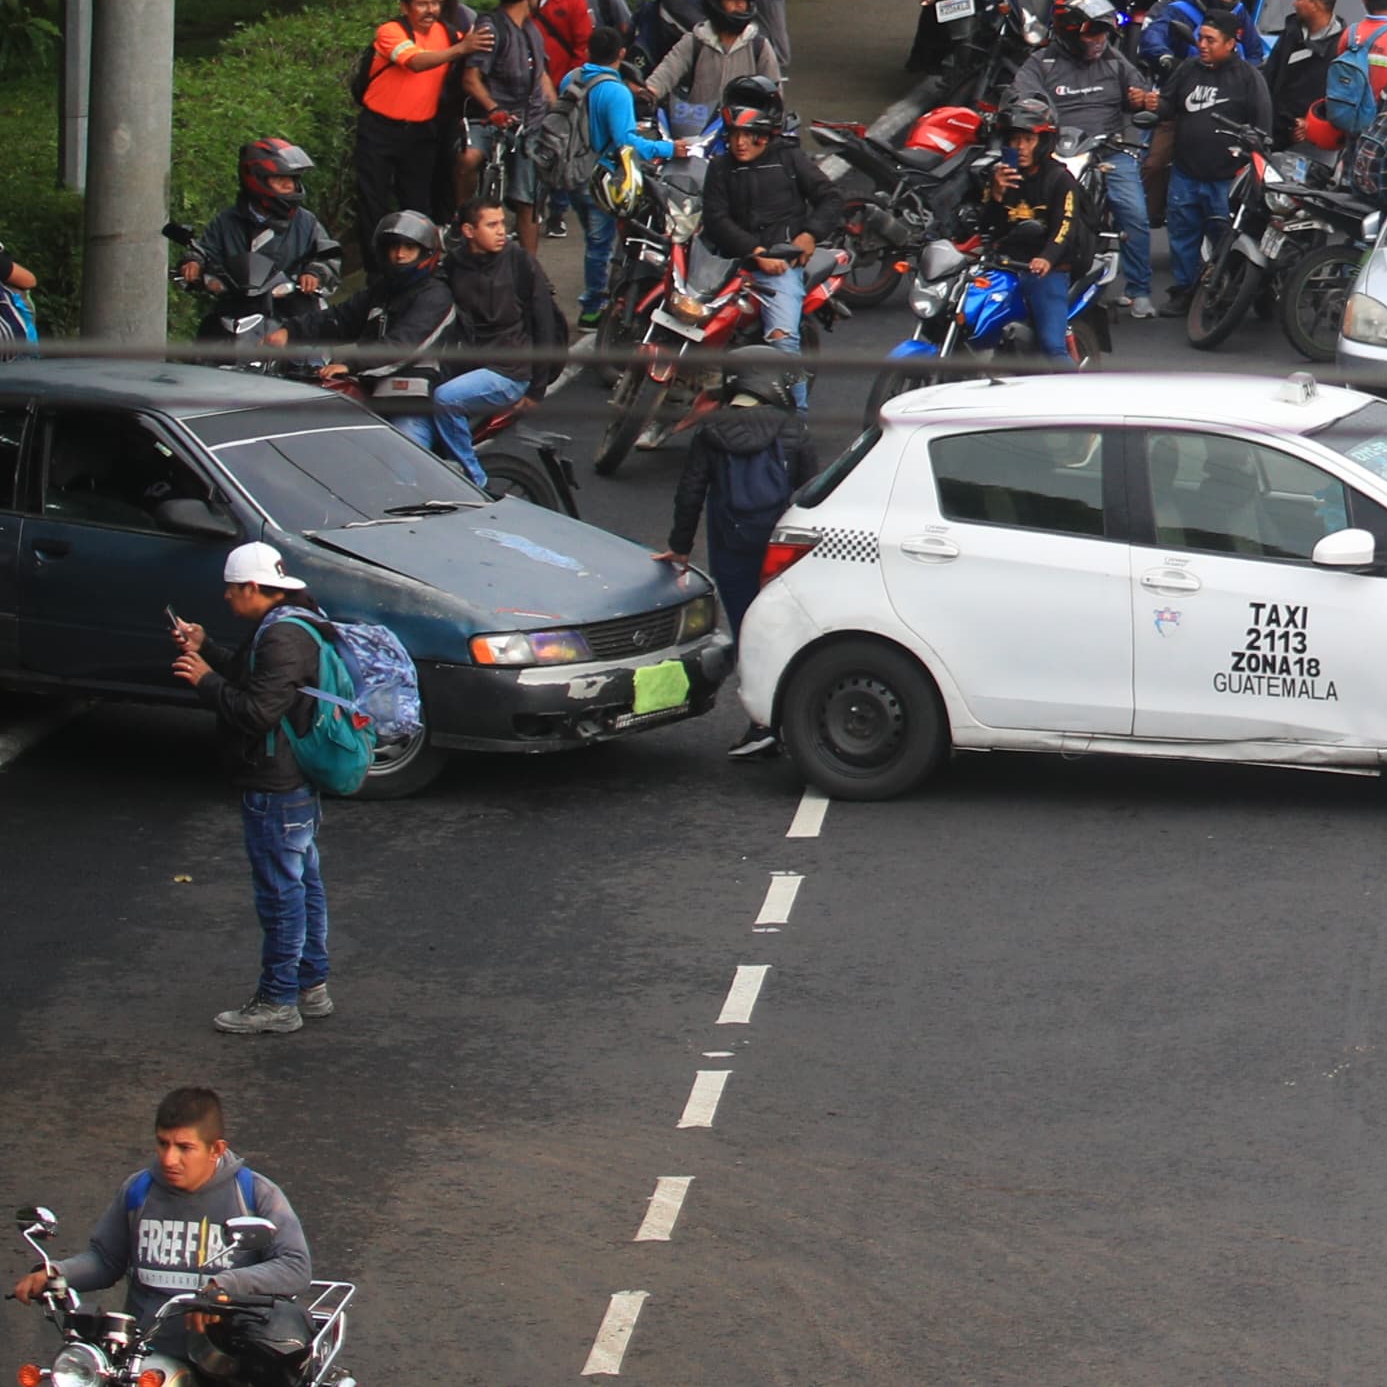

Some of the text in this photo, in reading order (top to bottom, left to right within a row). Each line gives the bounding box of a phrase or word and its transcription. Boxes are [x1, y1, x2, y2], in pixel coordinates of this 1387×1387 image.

[1192, 85, 1218, 105] NIKE
[1249, 602, 1309, 630] TAXI
[1245, 627, 1308, 655] 2113
[1212, 671, 1339, 702] GUATEMALA
[138, 1219, 185, 1266] FREE
